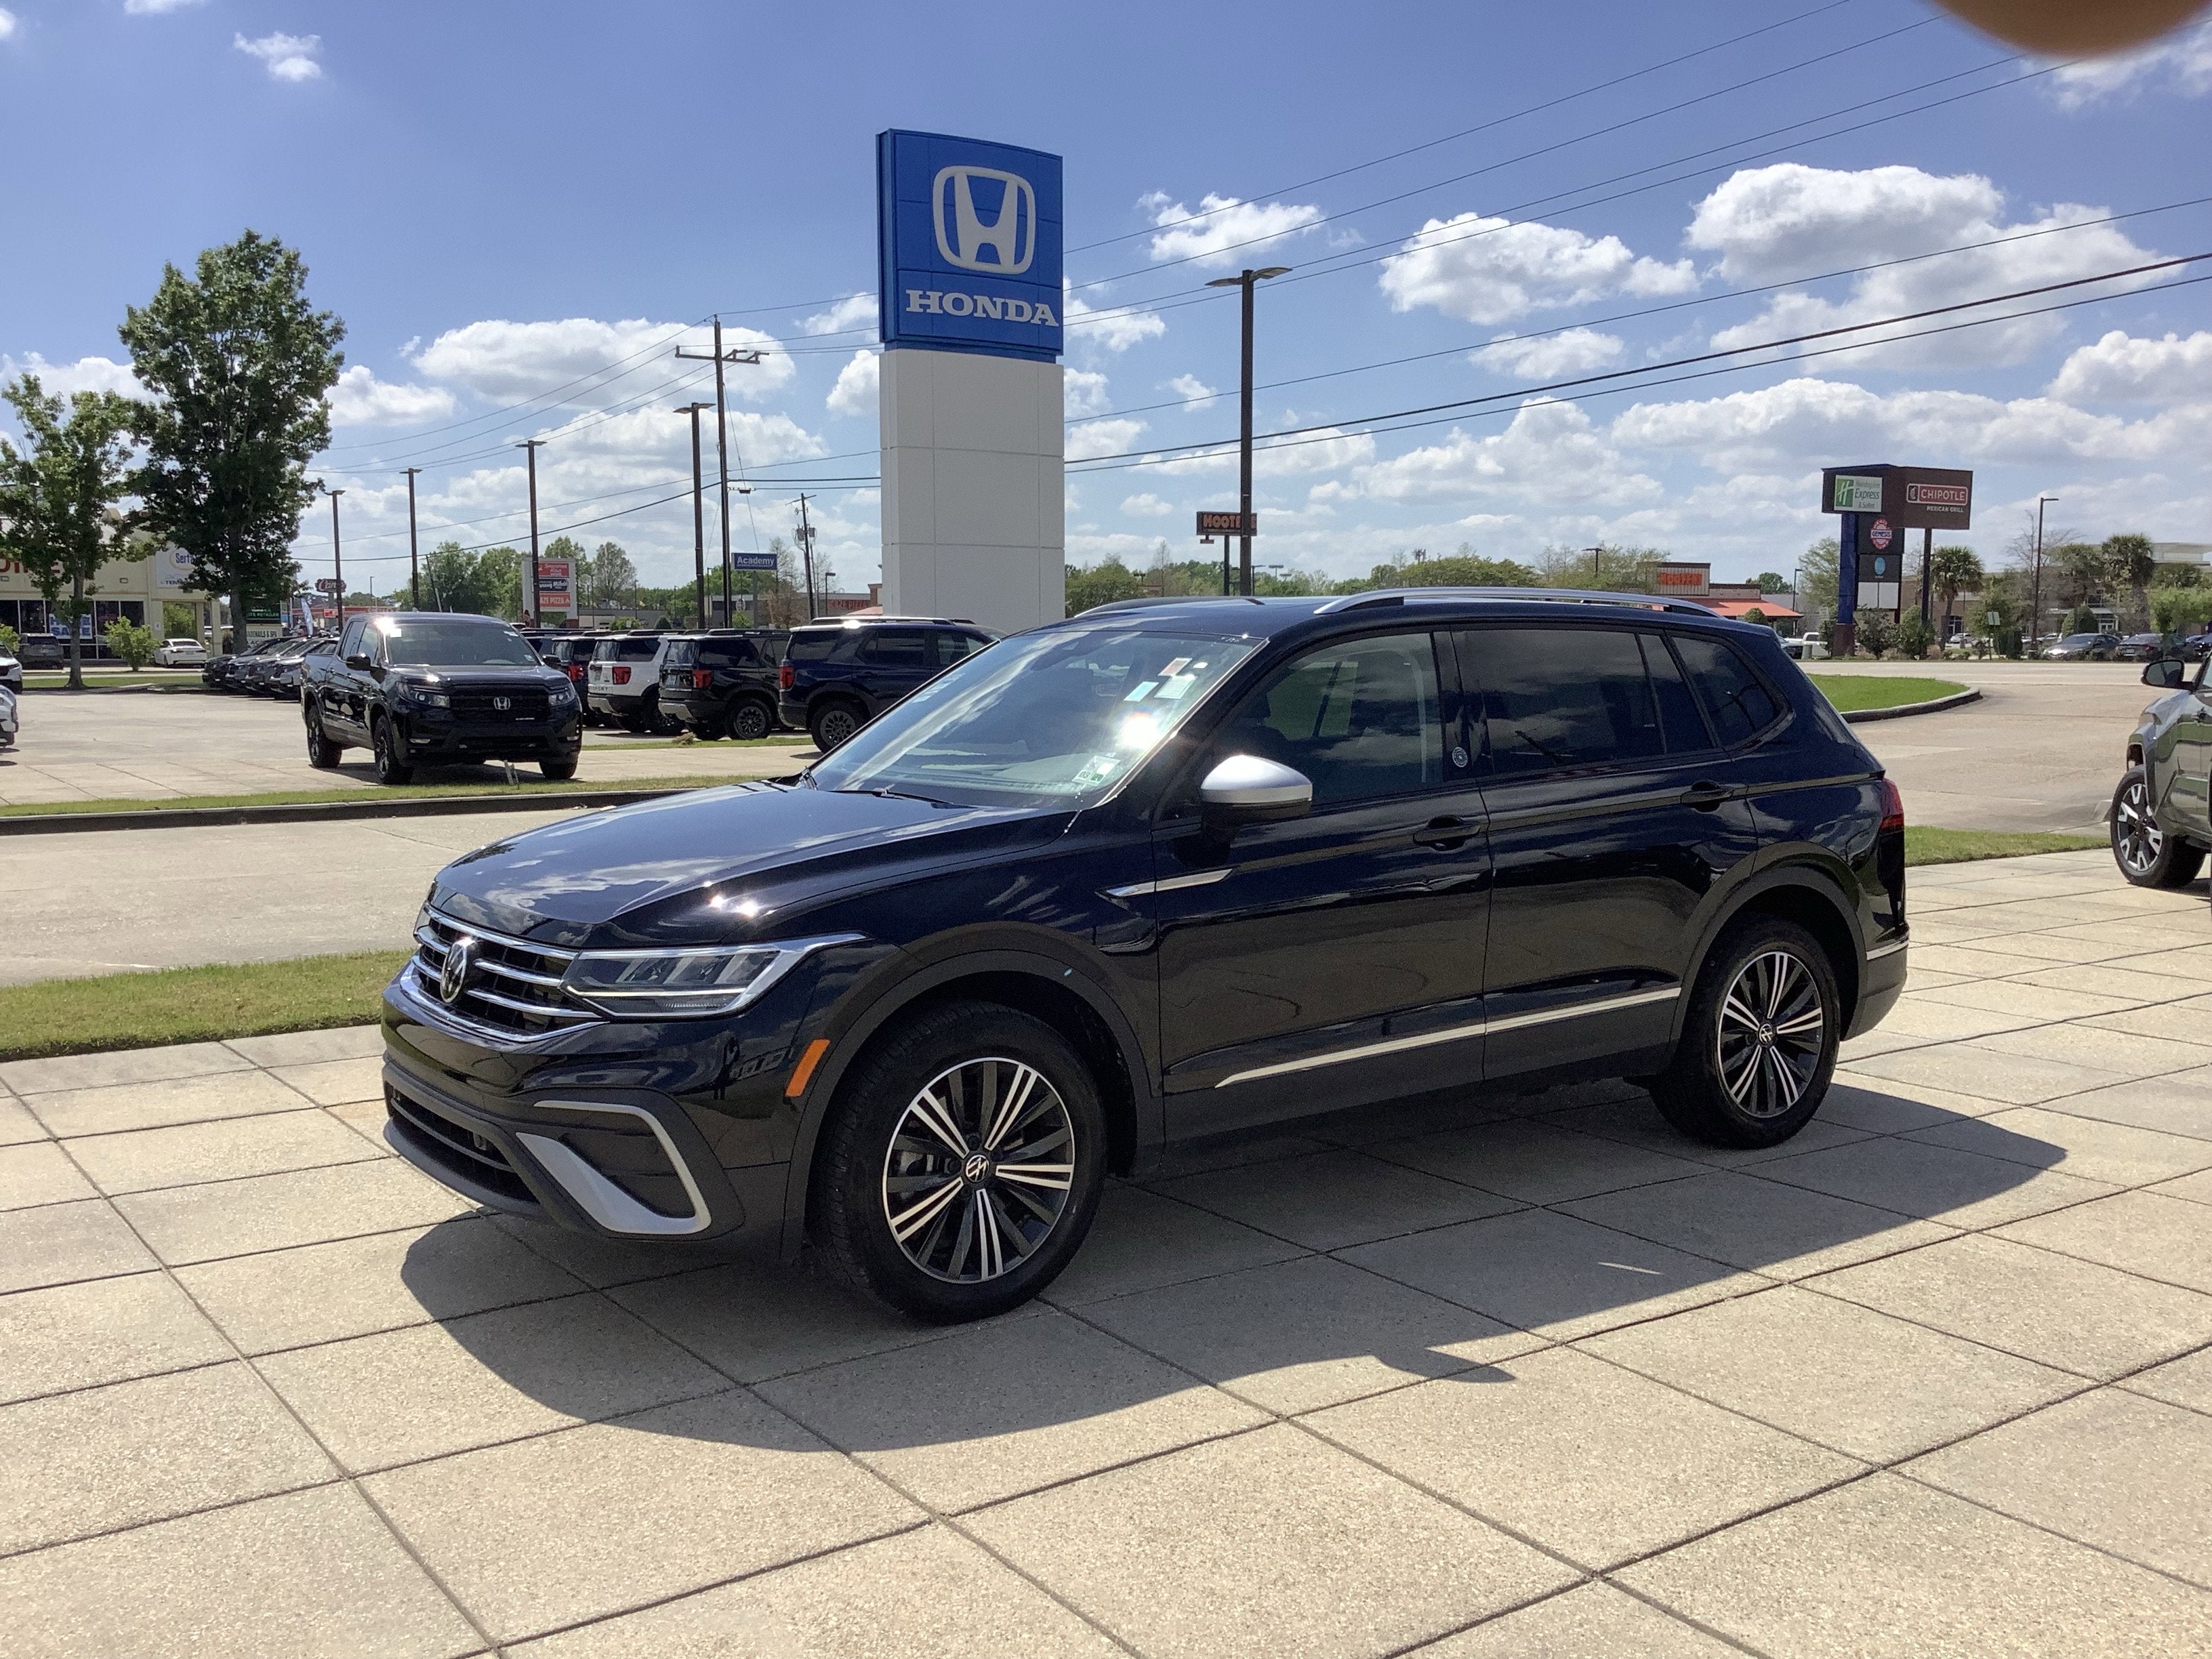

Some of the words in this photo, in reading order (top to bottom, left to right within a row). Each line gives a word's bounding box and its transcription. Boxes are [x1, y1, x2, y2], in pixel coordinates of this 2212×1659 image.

[905, 289, 1059, 327] HONDA
[1855, 488, 1879, 500] Express
[1921, 489, 1965, 501] CHIPOTLE
[737, 556, 775, 567] Academy
[51, 627, 91, 636] SAE
